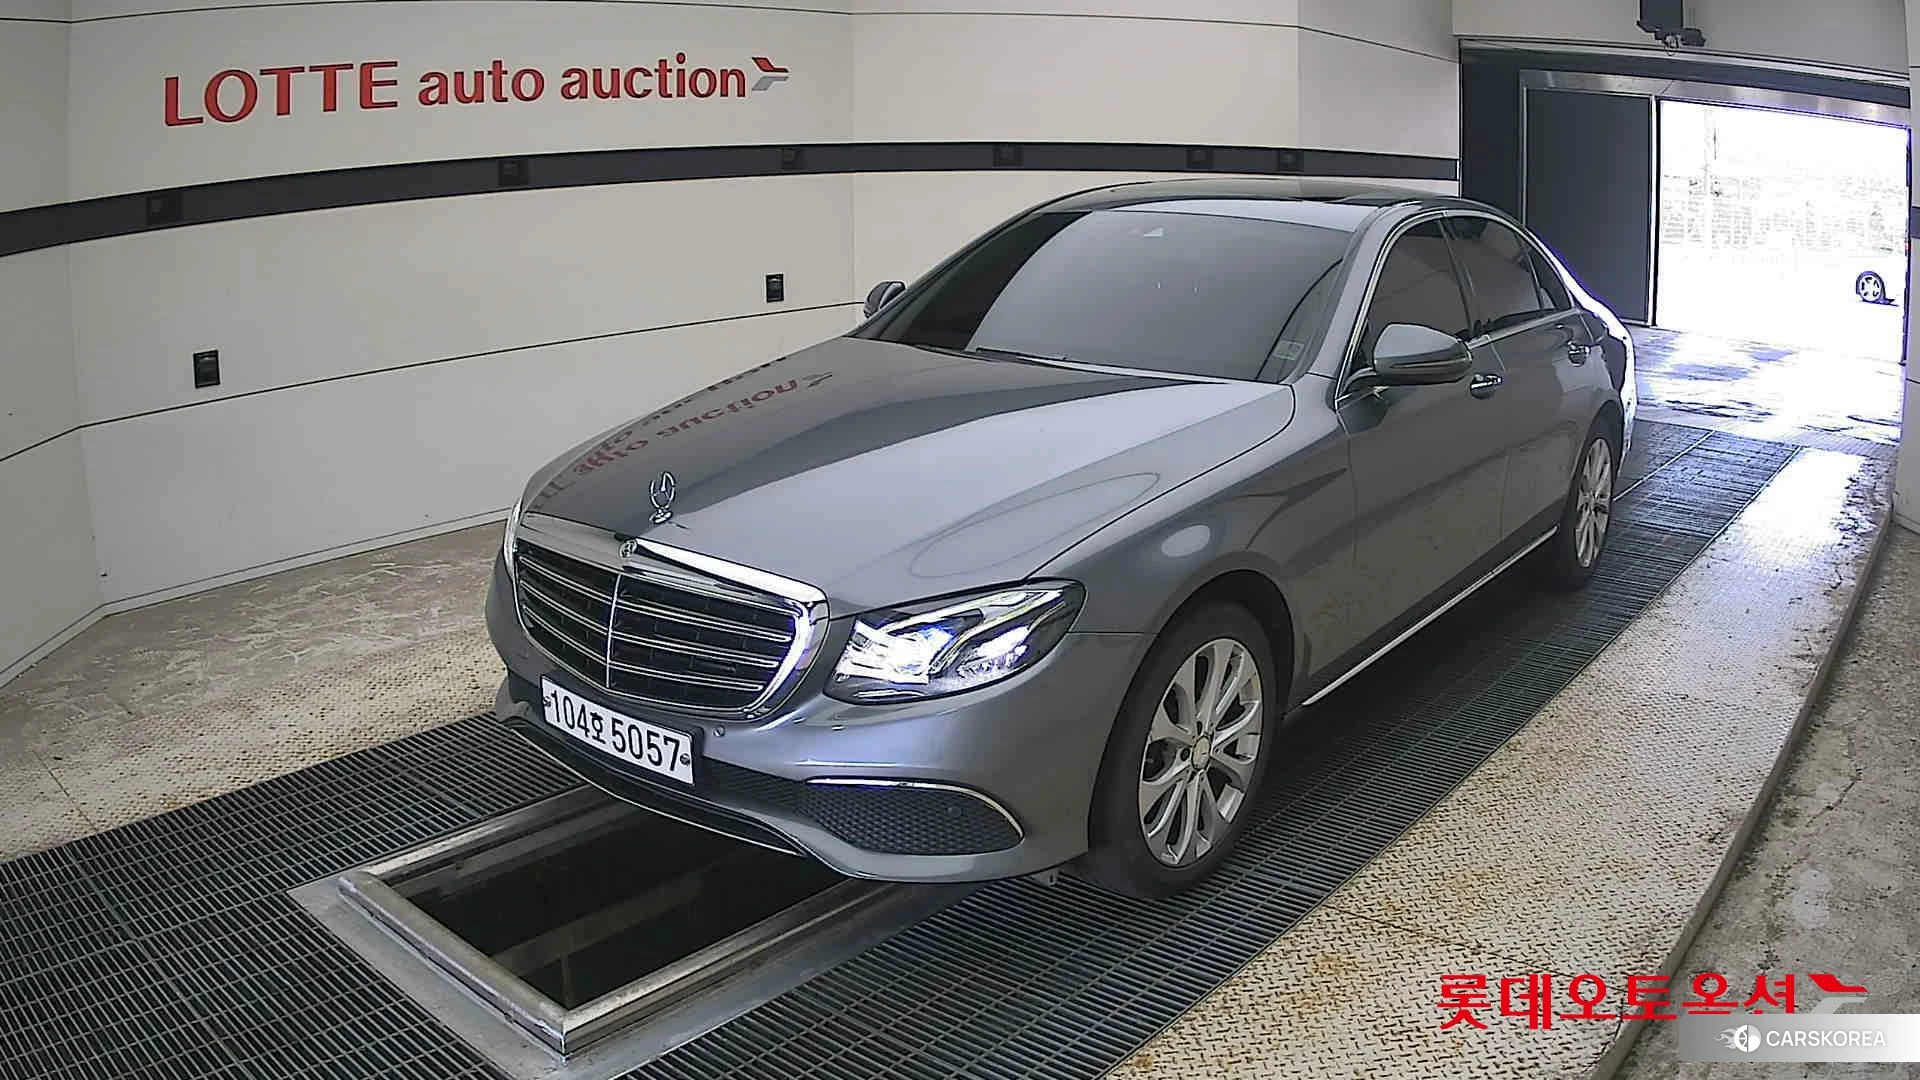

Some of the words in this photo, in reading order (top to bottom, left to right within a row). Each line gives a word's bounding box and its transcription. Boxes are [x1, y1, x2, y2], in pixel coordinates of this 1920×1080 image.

[164, 60, 399, 127] LOTTE
[418, 60, 545, 106] auto
[560, 52, 747, 99] auction
[551, 689, 606, 745] 104호
[611, 717, 681, 772] 5057
